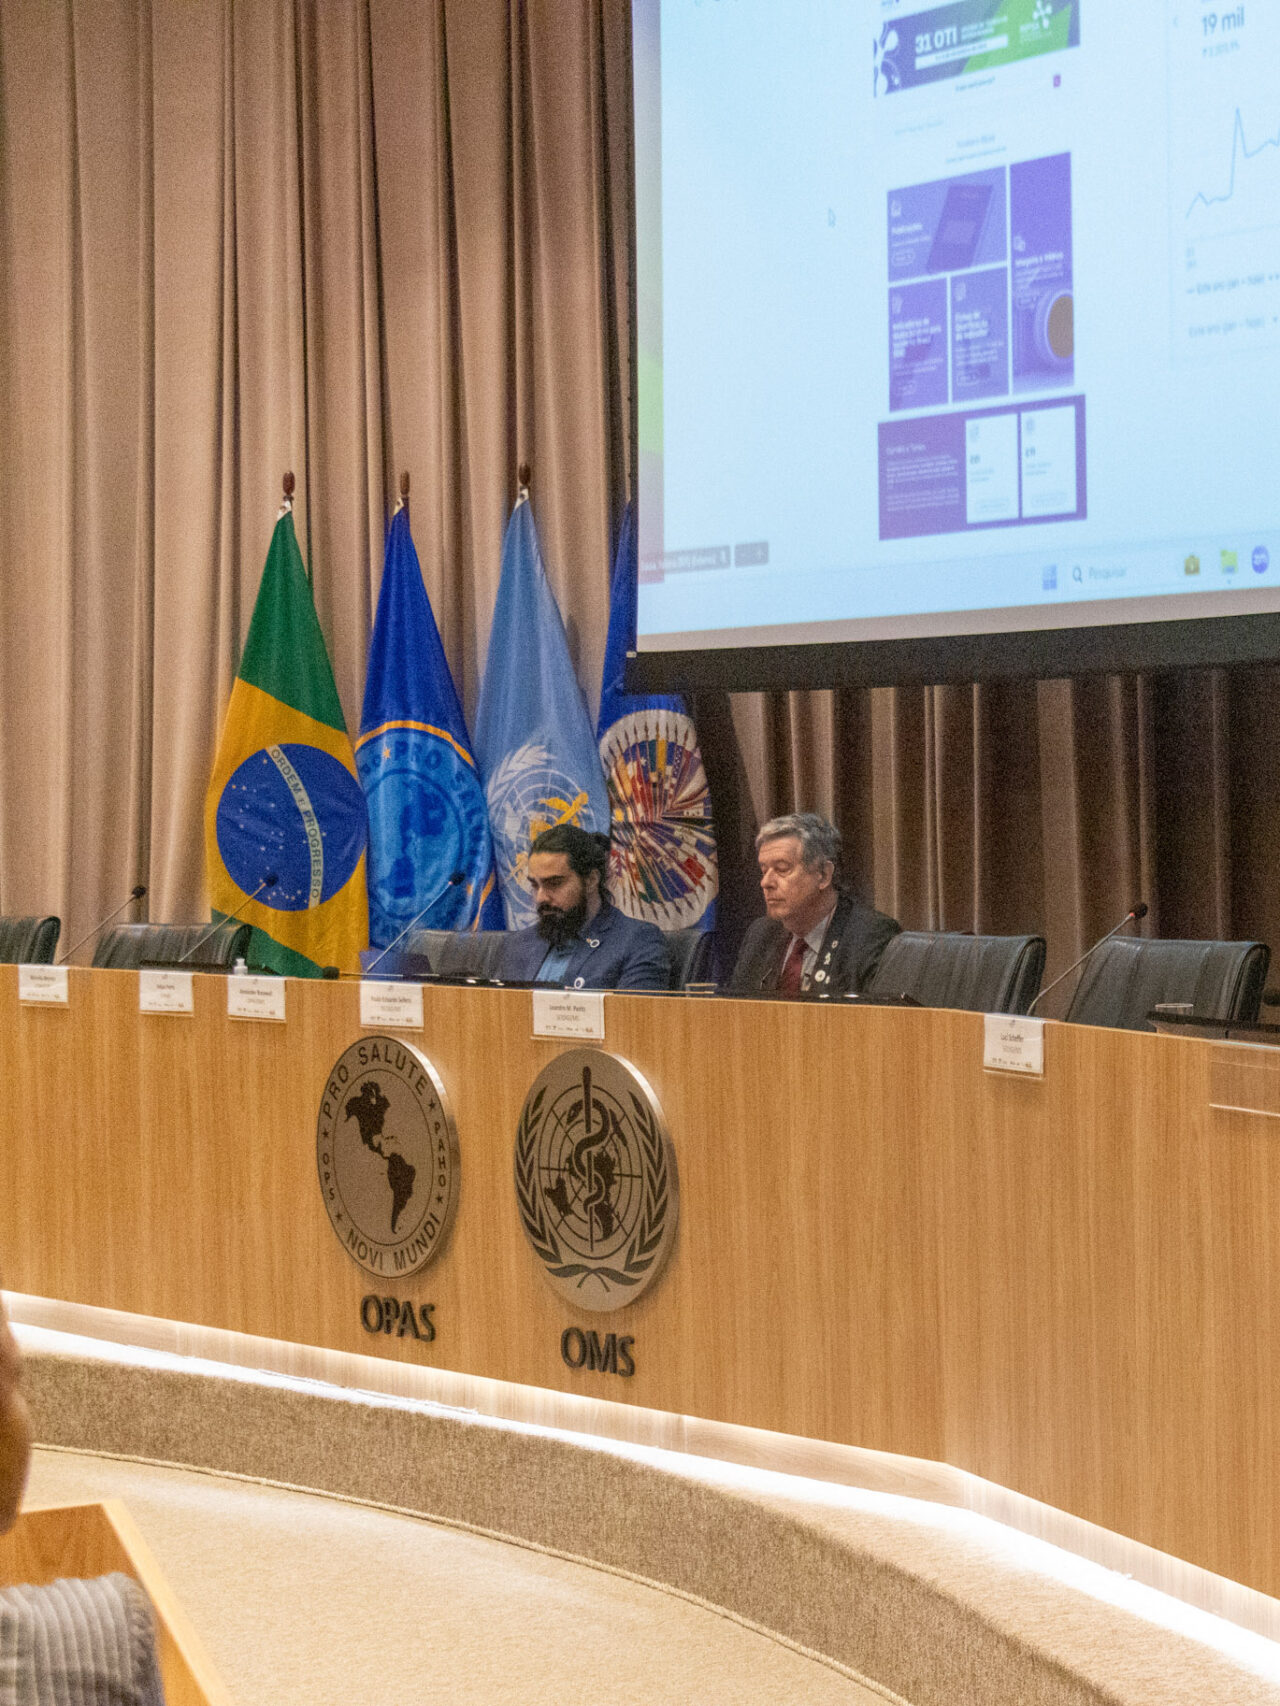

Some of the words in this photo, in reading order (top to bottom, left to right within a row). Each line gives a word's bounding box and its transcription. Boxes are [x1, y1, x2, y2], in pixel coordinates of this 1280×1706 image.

[1202, 13, 1217, 36] 19
[1221, 6, 1245, 32] mil
[271, 748, 303, 795] ORDEM
[303, 810, 322, 899] PROGRESSO
[323, 1064, 350, 1120] PRO
[358, 1042, 428, 1096] SALUTE
[322, 1152, 336, 1201] OPS
[434, 1121, 447, 1188] PAHO
[347, 1228, 384, 1271] NOVI
[393, 1211, 441, 1271] MUNDI
[360, 1294, 437, 1342] OPAS
[561, 1327, 636, 1377] OMS
